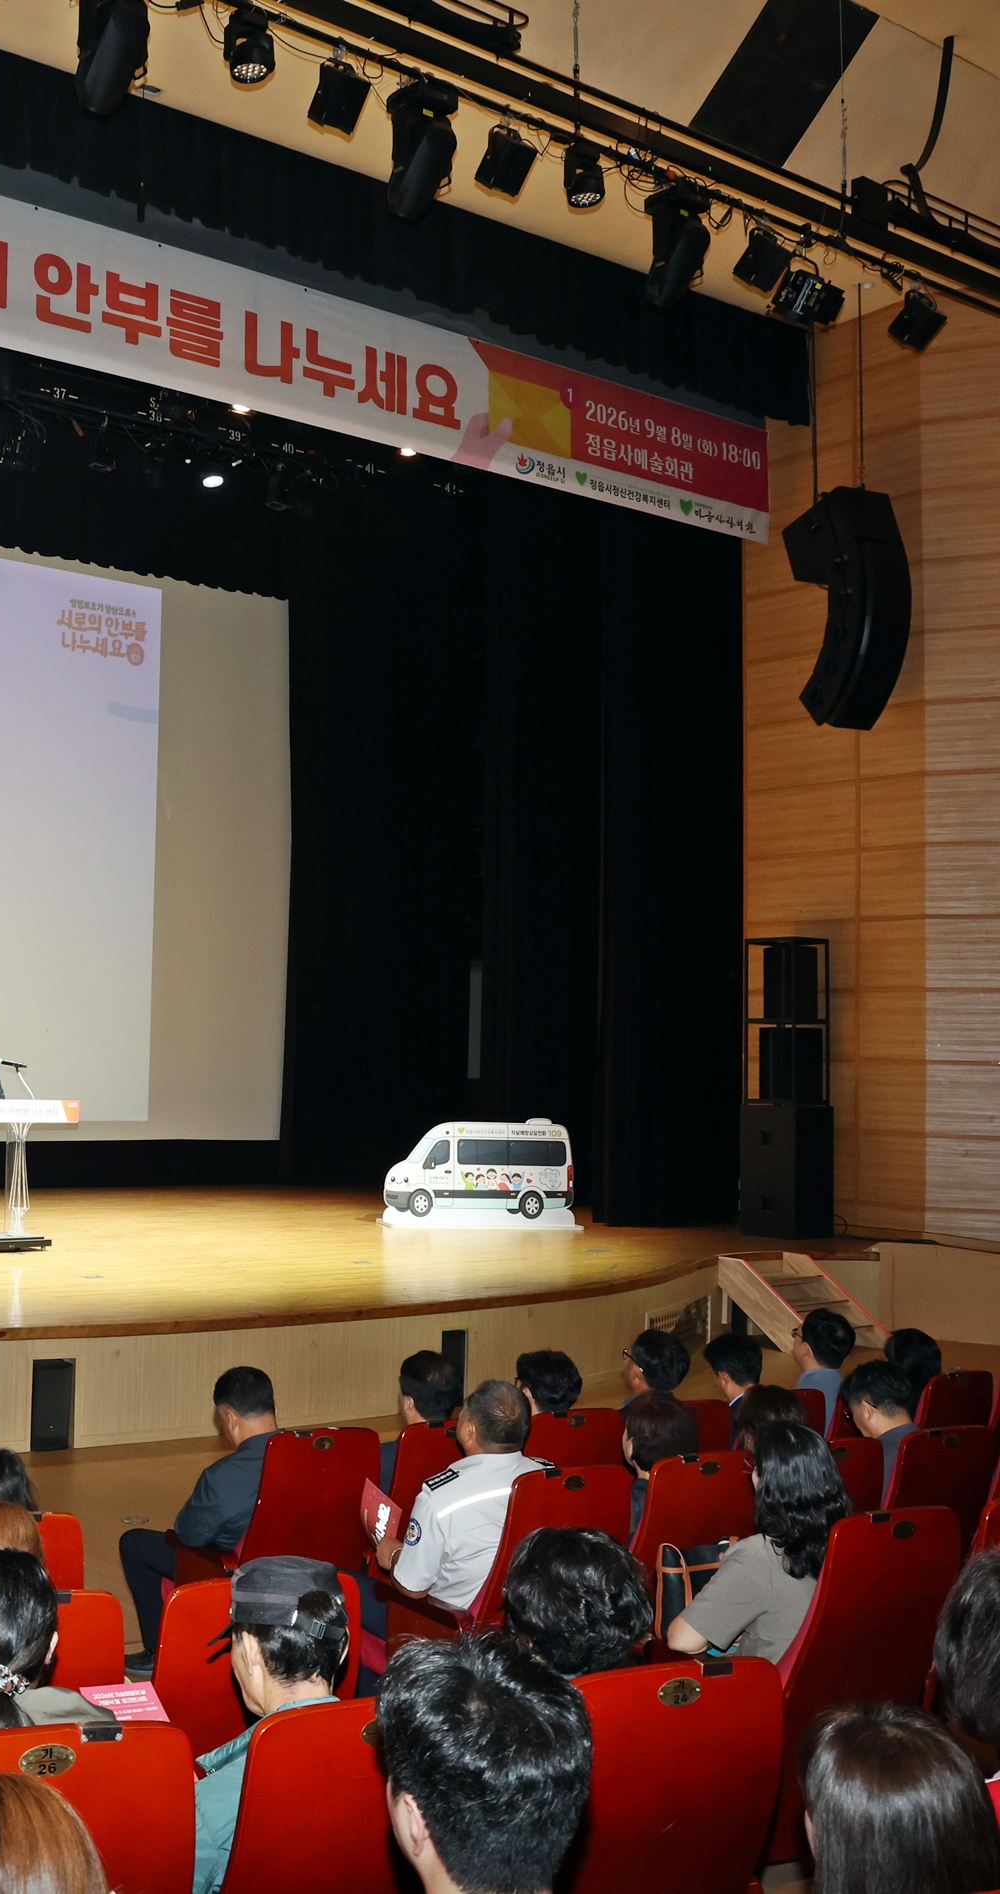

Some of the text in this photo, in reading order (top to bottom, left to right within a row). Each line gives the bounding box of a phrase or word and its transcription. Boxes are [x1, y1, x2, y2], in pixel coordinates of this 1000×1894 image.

[34, 252, 224, 368] 안부를
[244, 310, 461, 430] 나누세요
[585, 400, 761, 470] 2026년 9월 8일 (화) 18:00
[536, 459, 566, 478] 정읍시
[585, 432, 694, 484] 정읍사예술회관
[589, 478, 671, 510] 정읍시정신건강복지센터
[694, 508, 756, 534] 마음사랑병원
[57, 609, 147, 642] 서로의 안부를
[61, 632, 126, 658] 나누세요
[673, 1694, 688, 1704] 24
[42, 1748, 53, 1759] 가
[38, 1763, 57, 1775] 26
